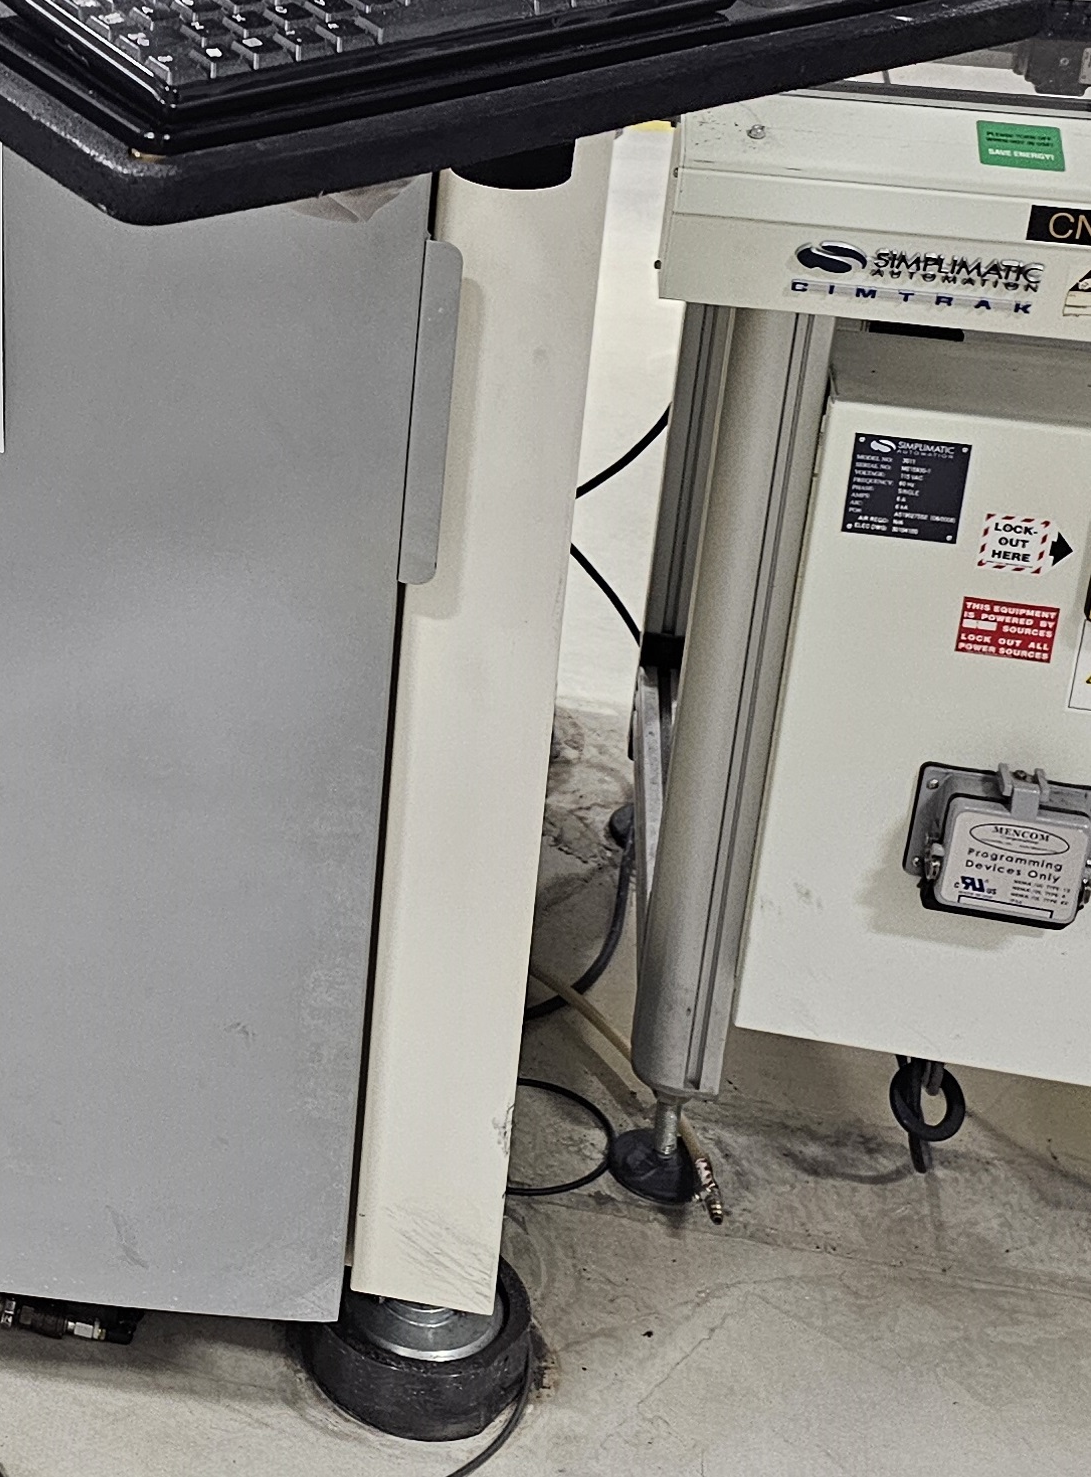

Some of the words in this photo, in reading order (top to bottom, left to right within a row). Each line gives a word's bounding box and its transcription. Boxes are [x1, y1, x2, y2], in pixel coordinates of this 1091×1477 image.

[873, 248, 1044, 284] SIMPLIMATIC
[871, 269, 1040, 293] AUTOMATION
[897, 441, 955, 455] SIMPLIMATIC
[994, 522, 1038, 535] LOCK-
[998, 537, 1030, 549] OUT
[991, 549, 1031, 562] HERE
[966, 602, 991, 611] THIS
[993, 605, 1058, 619] EQUIPMENT
[981, 613, 1034, 626] POWERED
[1039, 620, 1055, 629] BY
[1002, 625, 1053, 638] SOURCES
[960, 633, 992, 643] LOCK
[998, 638, 1023, 647] OUT
[1028, 641, 1050, 651] ALL
[958, 642, 997, 653] POWER
[998, 647, 1049, 660] SOURCES
[992, 826, 1050, 842] MENCOM
[967, 847, 1063, 872] Programming
[965, 859, 1022, 876] Devices
[1028, 870, 1061, 884] Only
